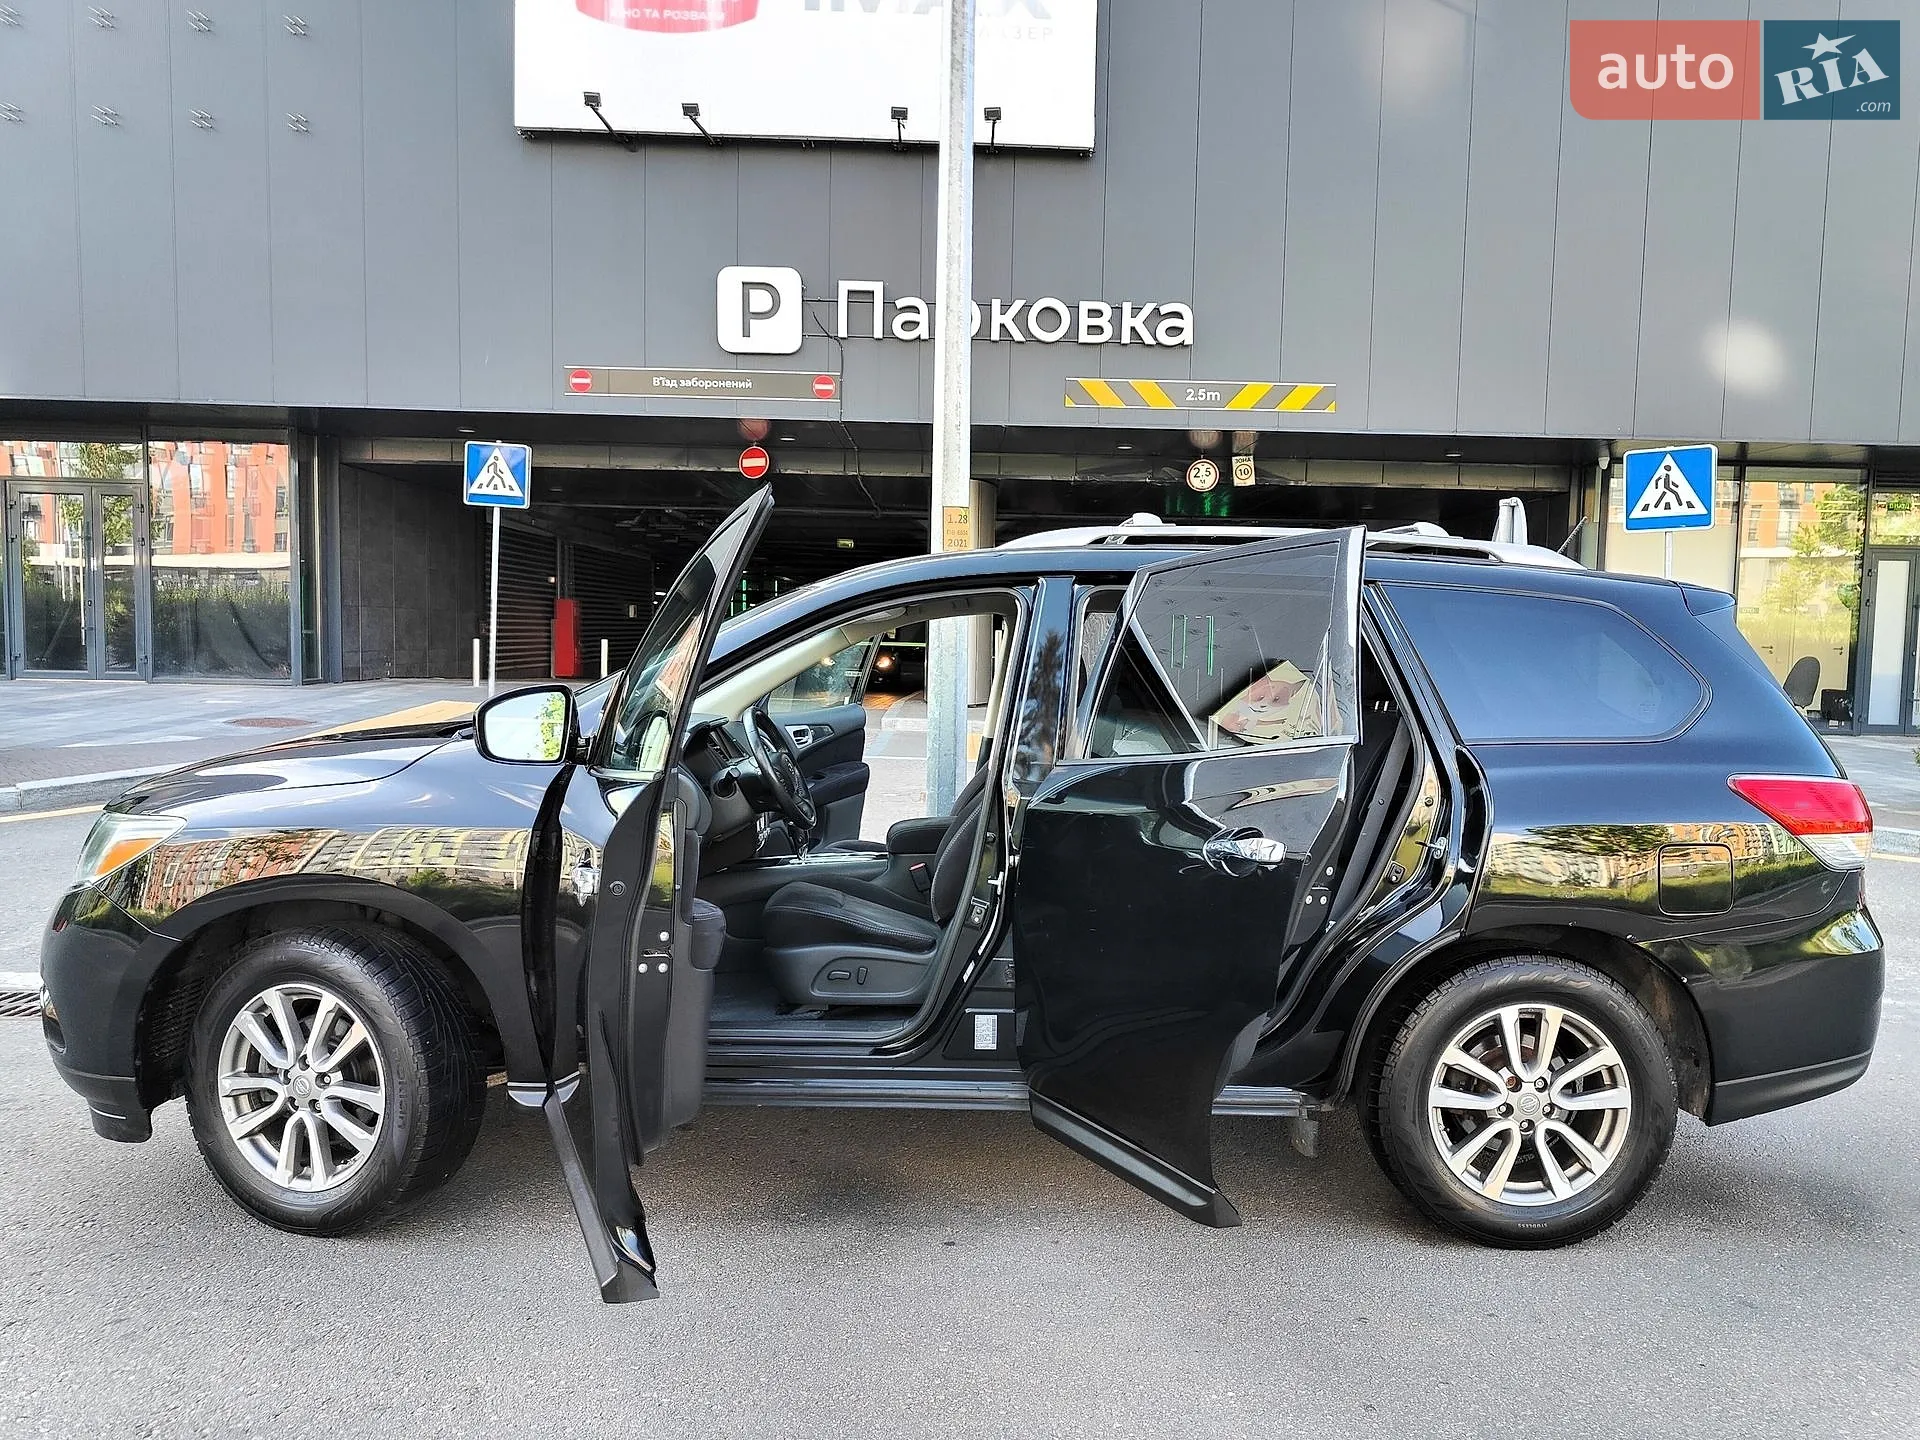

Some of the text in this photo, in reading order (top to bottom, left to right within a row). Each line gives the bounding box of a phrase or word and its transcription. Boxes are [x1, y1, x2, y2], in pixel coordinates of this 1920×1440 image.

[645, 9, 660, 19] ТА
[838, 279, 1195, 346] Паковка
[679, 377, 753, 389] заборонений
[1185, 388, 1221, 401] 2.5m
[1239, 468, 1250, 476] 10
[947, 514, 968, 524] 1.28
[947, 539, 968, 548] 2021
